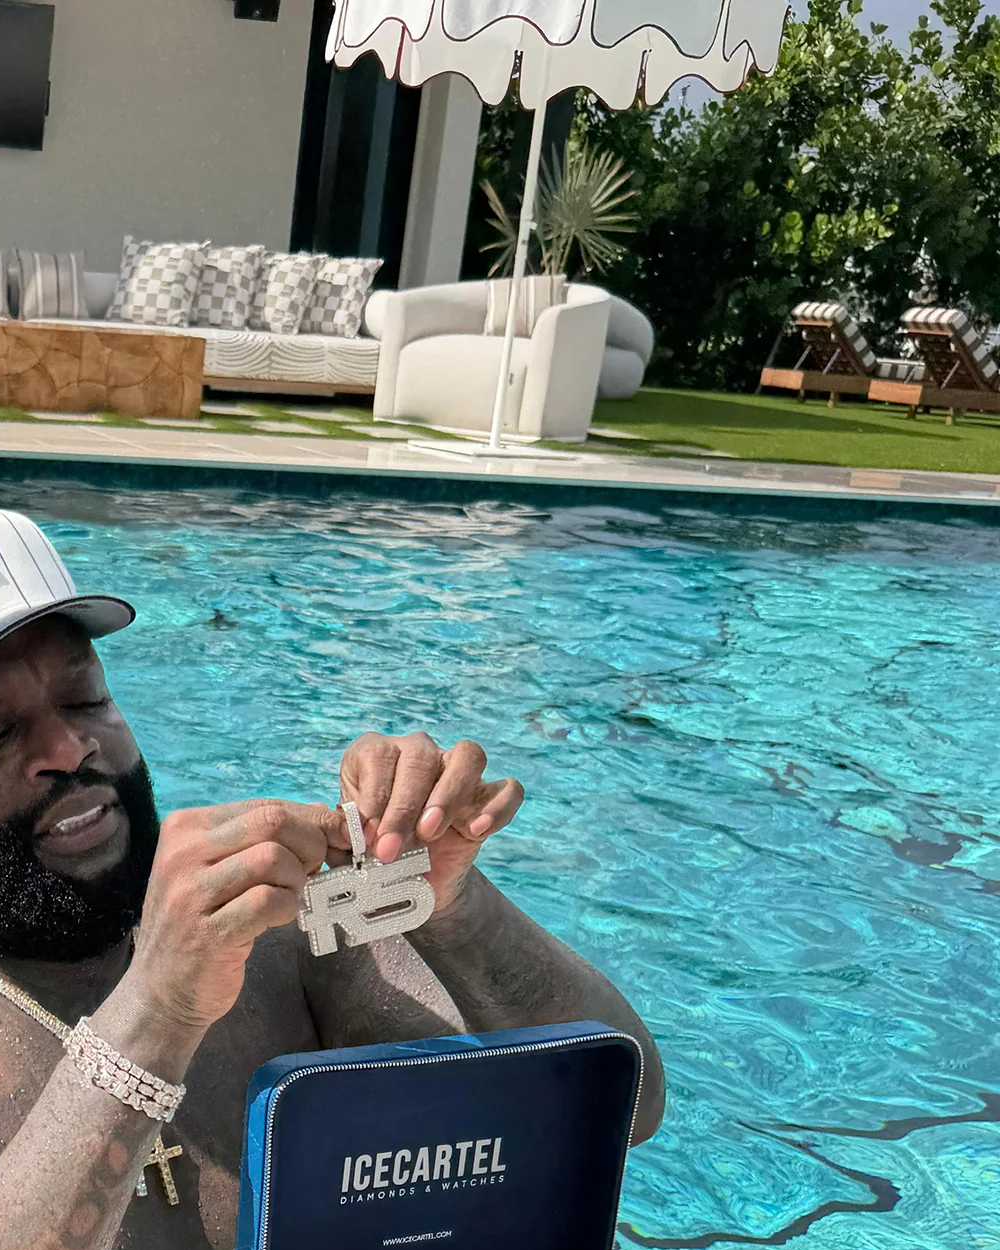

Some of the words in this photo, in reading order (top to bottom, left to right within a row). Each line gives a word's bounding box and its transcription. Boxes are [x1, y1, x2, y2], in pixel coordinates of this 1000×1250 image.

[341, 1137, 506, 1193] ICECARTEL
[340, 1187, 416, 1205] DIAMONDS
[425, 1185, 432, 1193] &
[442, 1175, 506, 1191] WATCHES
[382, 1230, 452, 1247] WWW.ICECARTEL.COM
